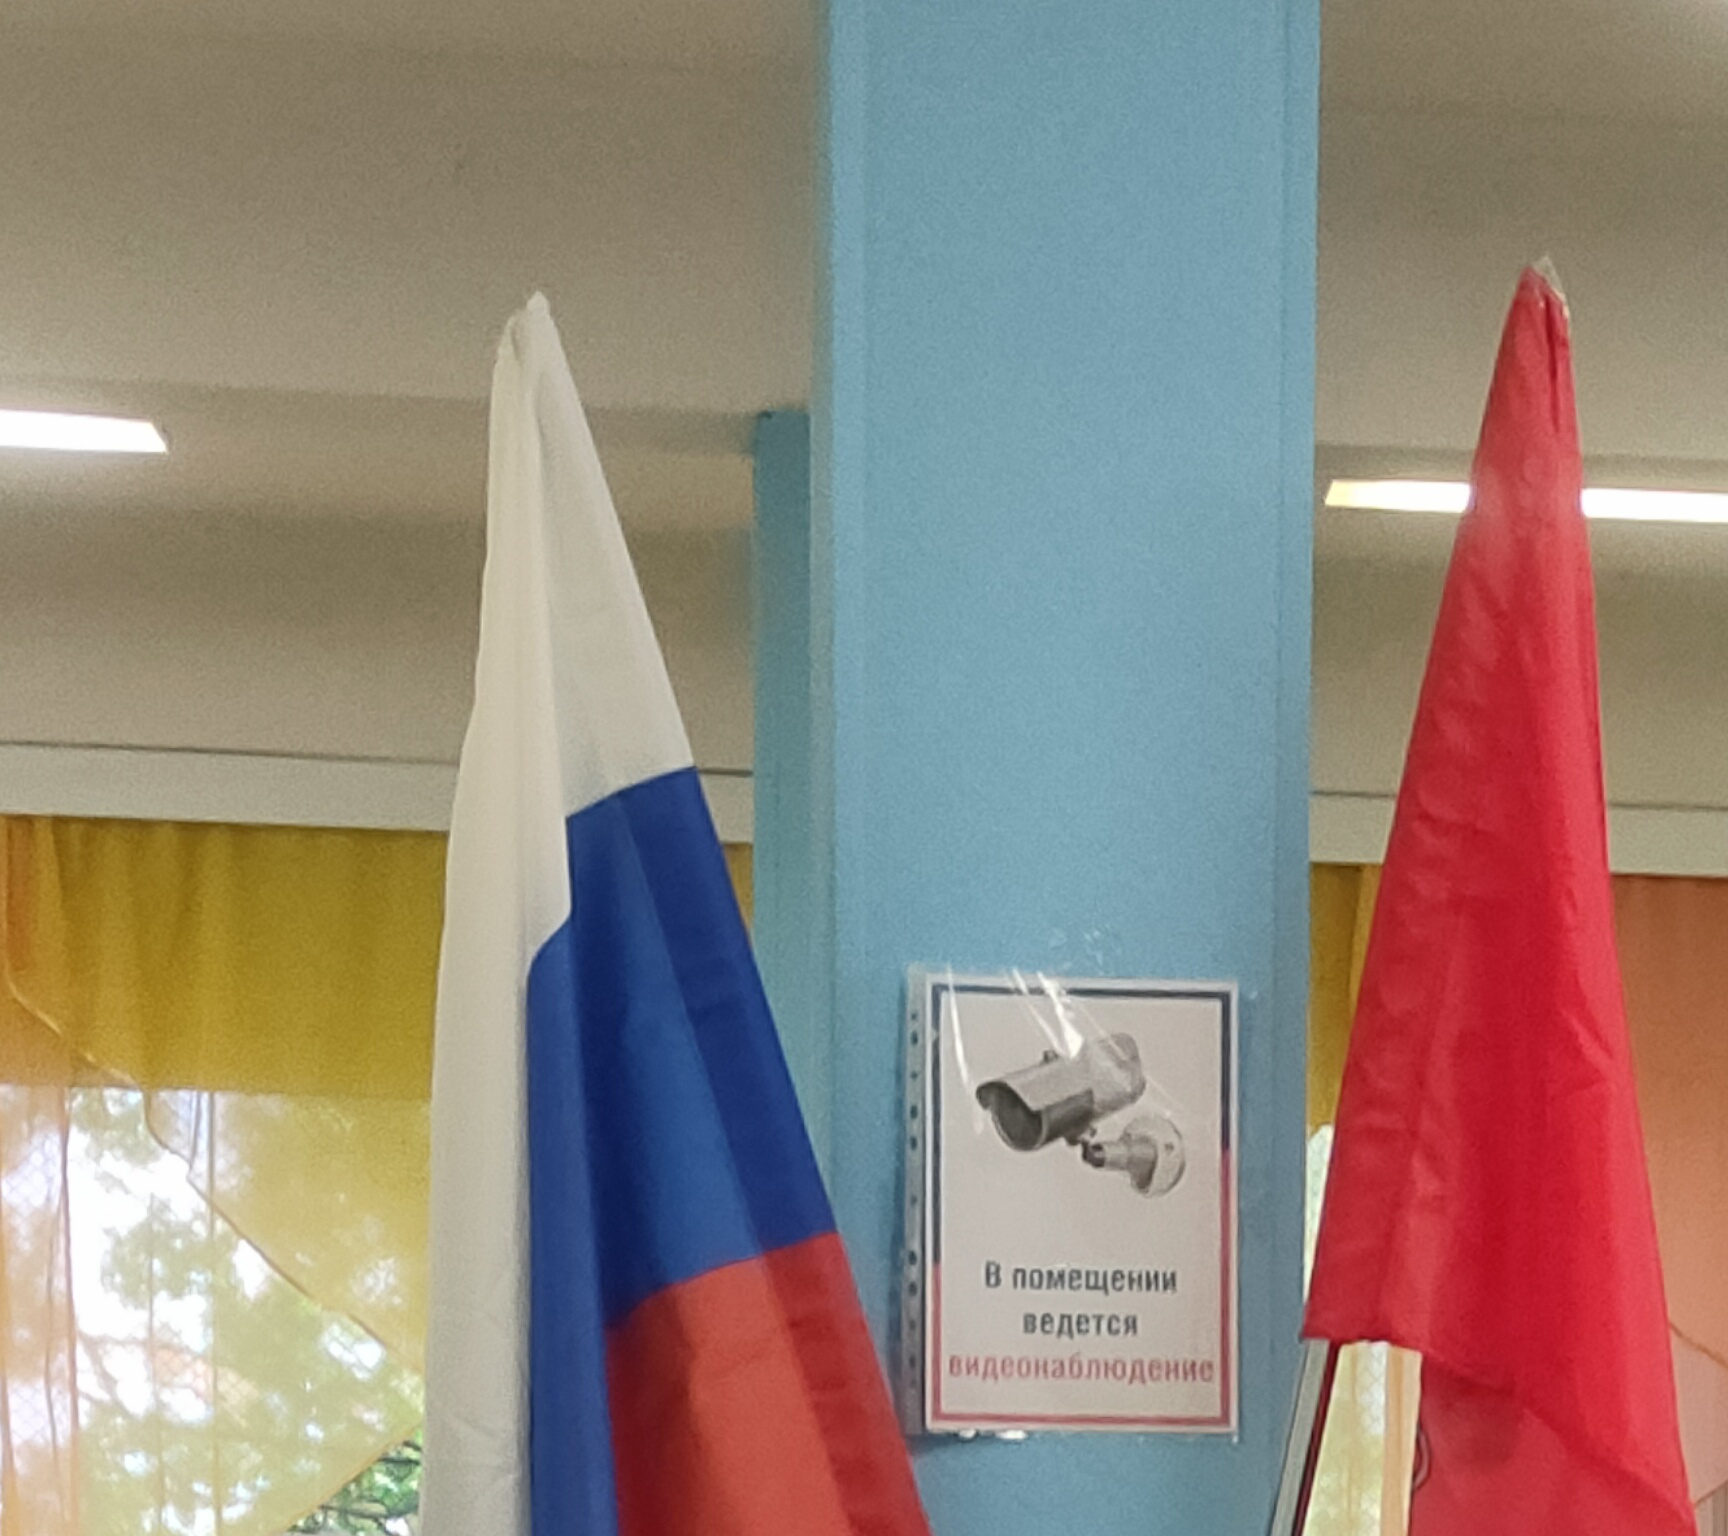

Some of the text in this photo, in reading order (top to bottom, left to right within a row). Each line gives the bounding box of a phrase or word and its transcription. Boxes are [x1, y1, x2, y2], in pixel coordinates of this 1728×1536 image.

[984, 1261, 1177, 1296] В помещении
[1022, 1312, 1139, 1340] ведется
[948, 1353, 1215, 1386] видеонаблюдение
